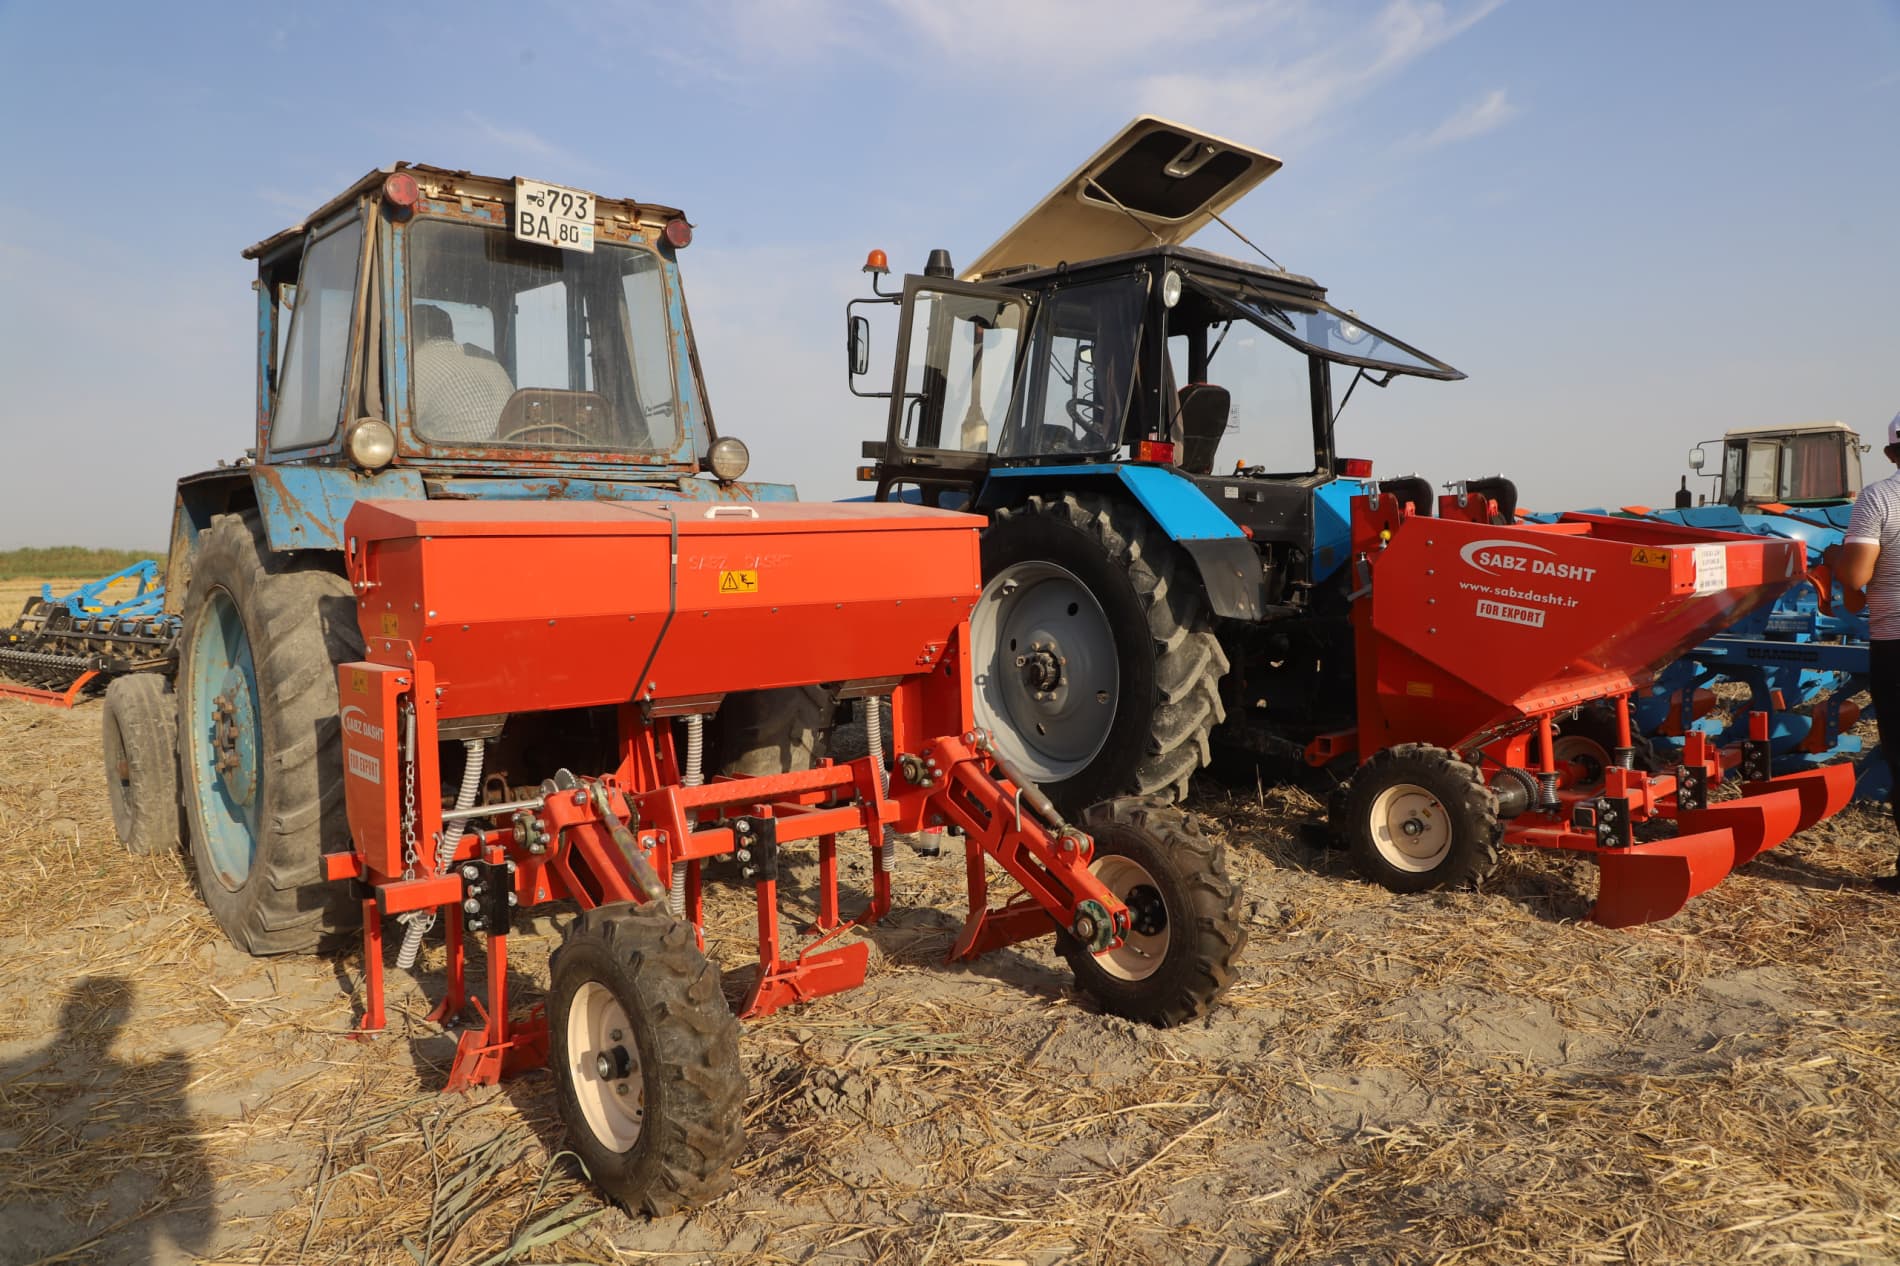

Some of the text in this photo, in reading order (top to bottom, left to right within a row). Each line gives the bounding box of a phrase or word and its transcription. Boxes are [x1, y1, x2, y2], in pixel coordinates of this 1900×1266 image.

[547, 189, 588, 220] 793
[520, 211, 579, 243] BA 80
[1479, 552, 1597, 583] SABZ DASHT
[1459, 581, 1579, 608] www.sabzdasht.ir
[1480, 603, 1542, 623] FOR EXPORT
[363, 722, 384, 743] DASHT
[350, 753, 378, 777] FOR EXPORT
